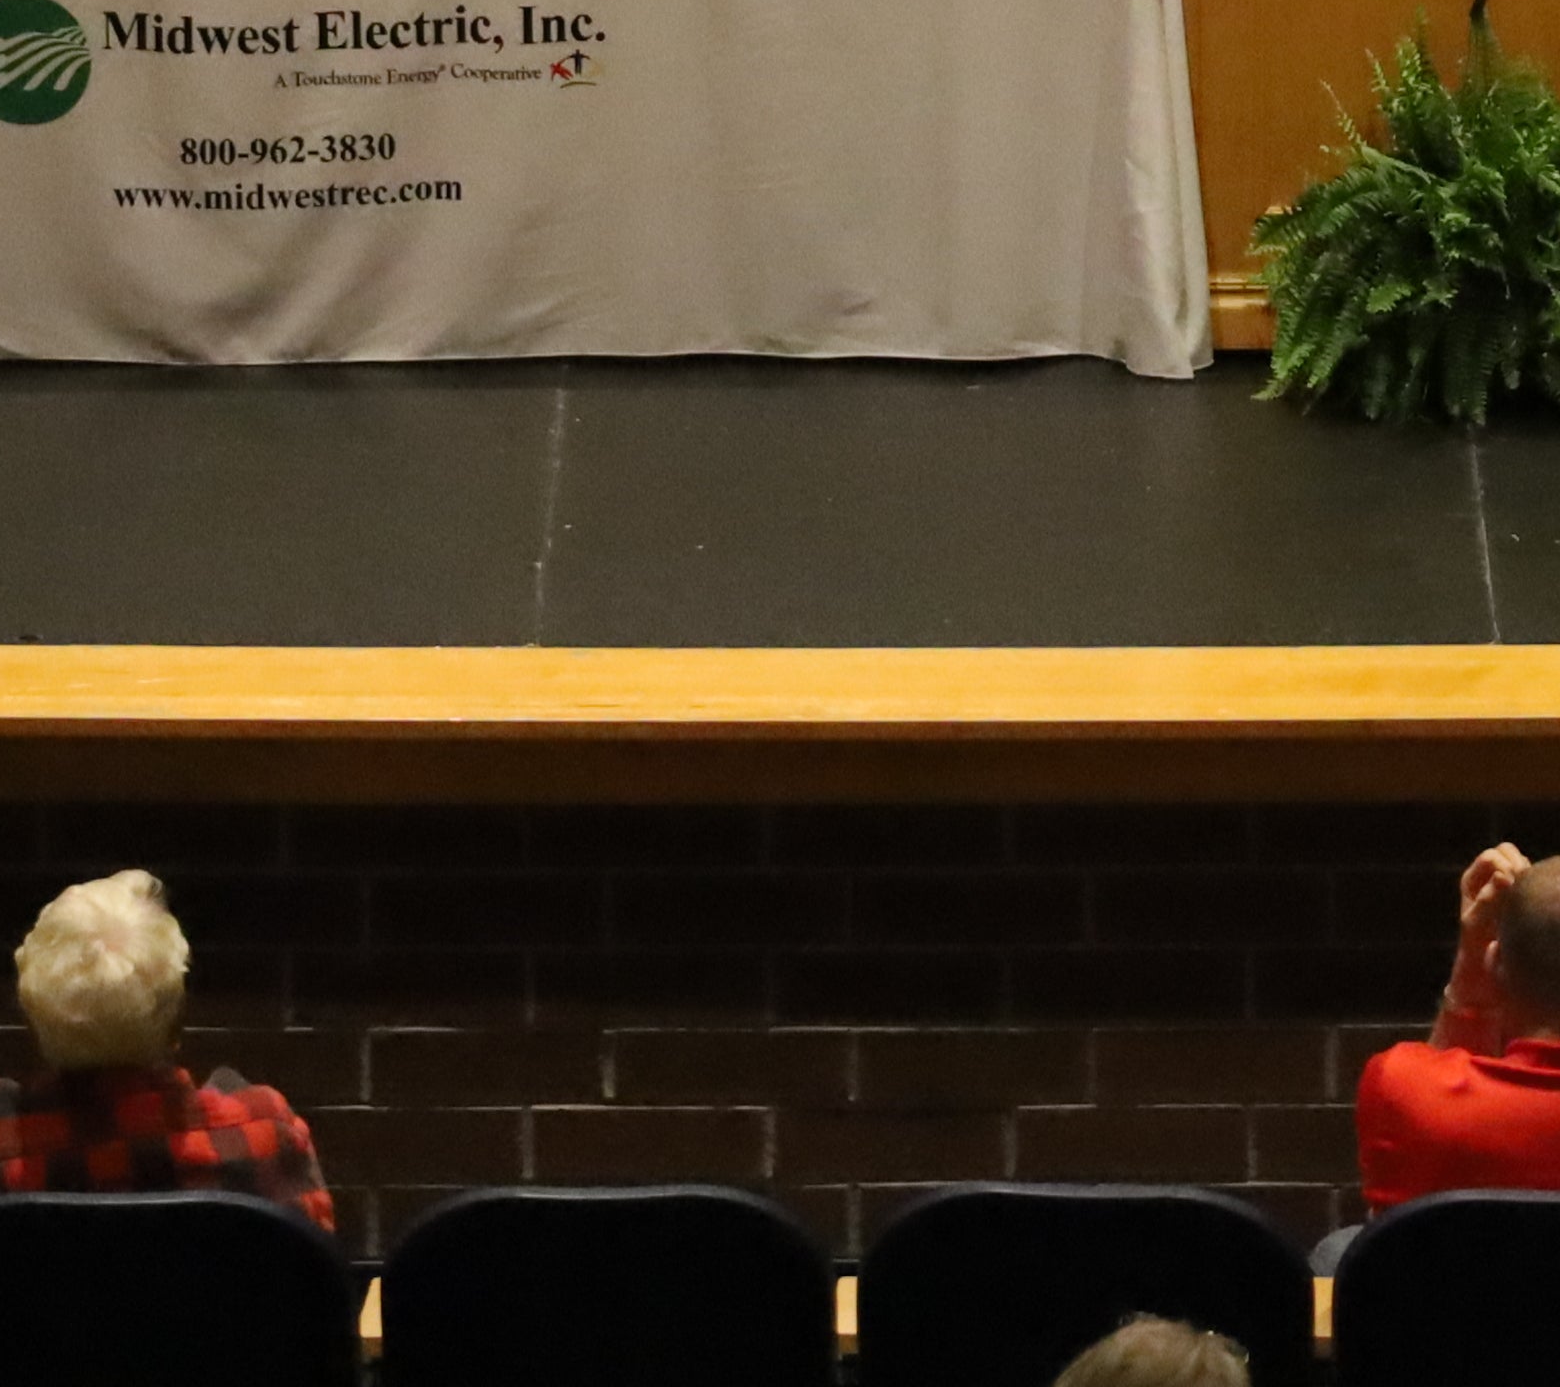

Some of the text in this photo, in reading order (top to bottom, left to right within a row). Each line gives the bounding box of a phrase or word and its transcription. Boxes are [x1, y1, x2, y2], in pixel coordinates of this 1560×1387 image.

[103, 4, 606, 55] Midwest Electric, Inc.
[275, 74, 288, 89] A
[291, 70, 382, 88] Touchstone
[449, 63, 542, 83] Cooperative
[179, 133, 396, 166] 800-962-3830
[113, 180, 462, 211] www.midwestrec.com
